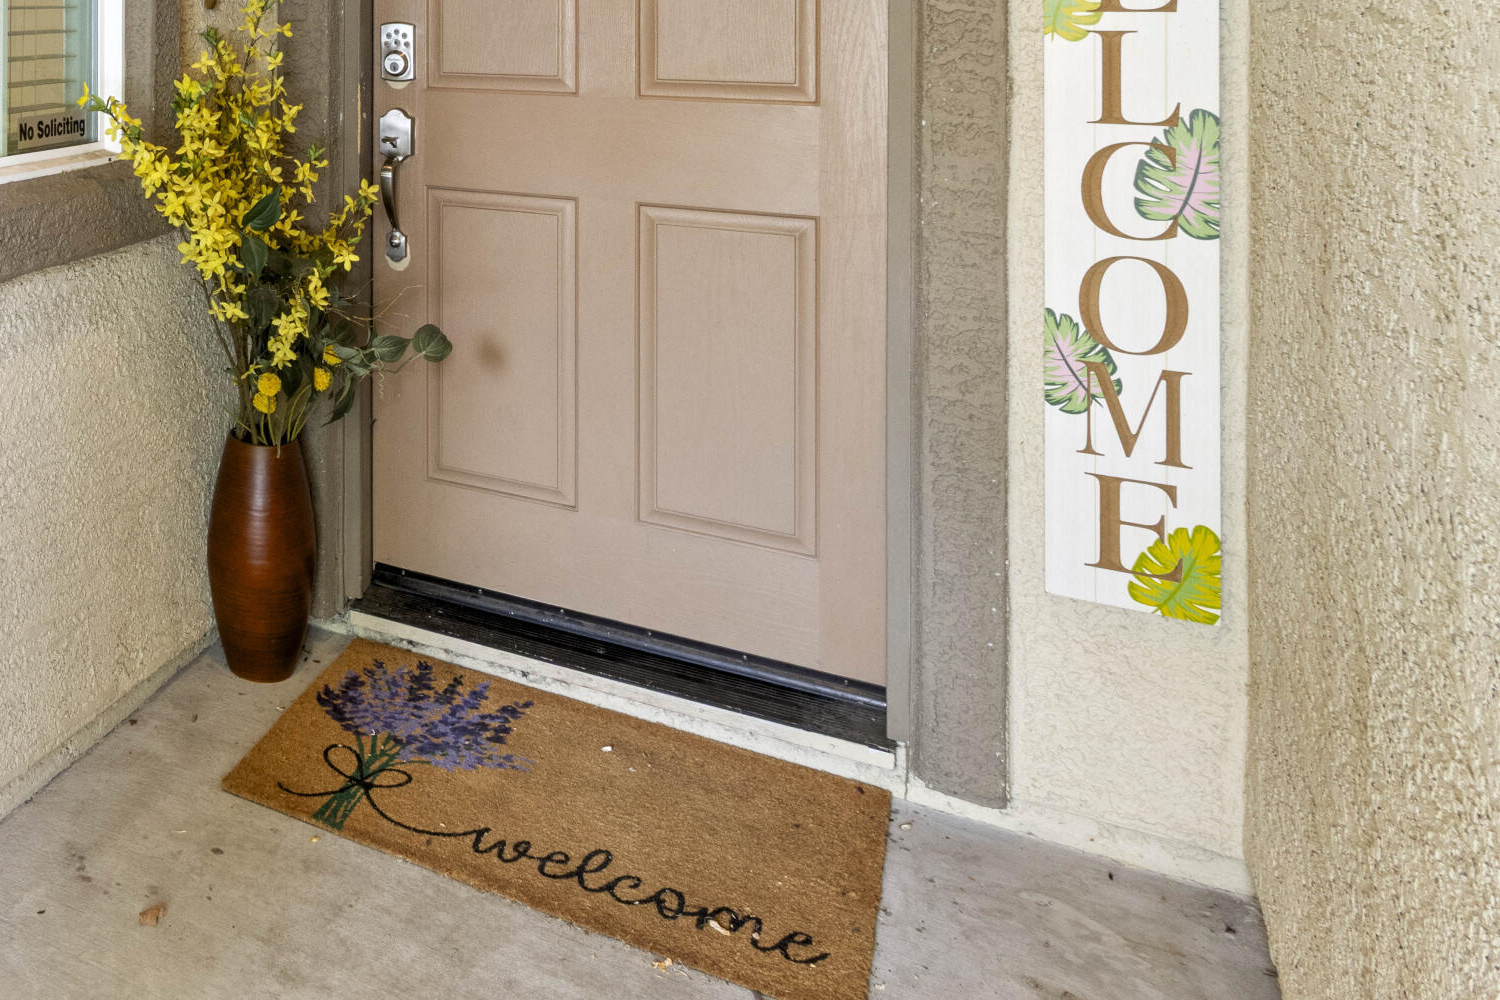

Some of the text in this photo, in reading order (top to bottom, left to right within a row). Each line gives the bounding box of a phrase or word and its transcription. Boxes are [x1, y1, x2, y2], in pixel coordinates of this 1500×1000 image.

[19, 116, 86, 142] No Soliciting
[466, 826, 831, 965] welcome
